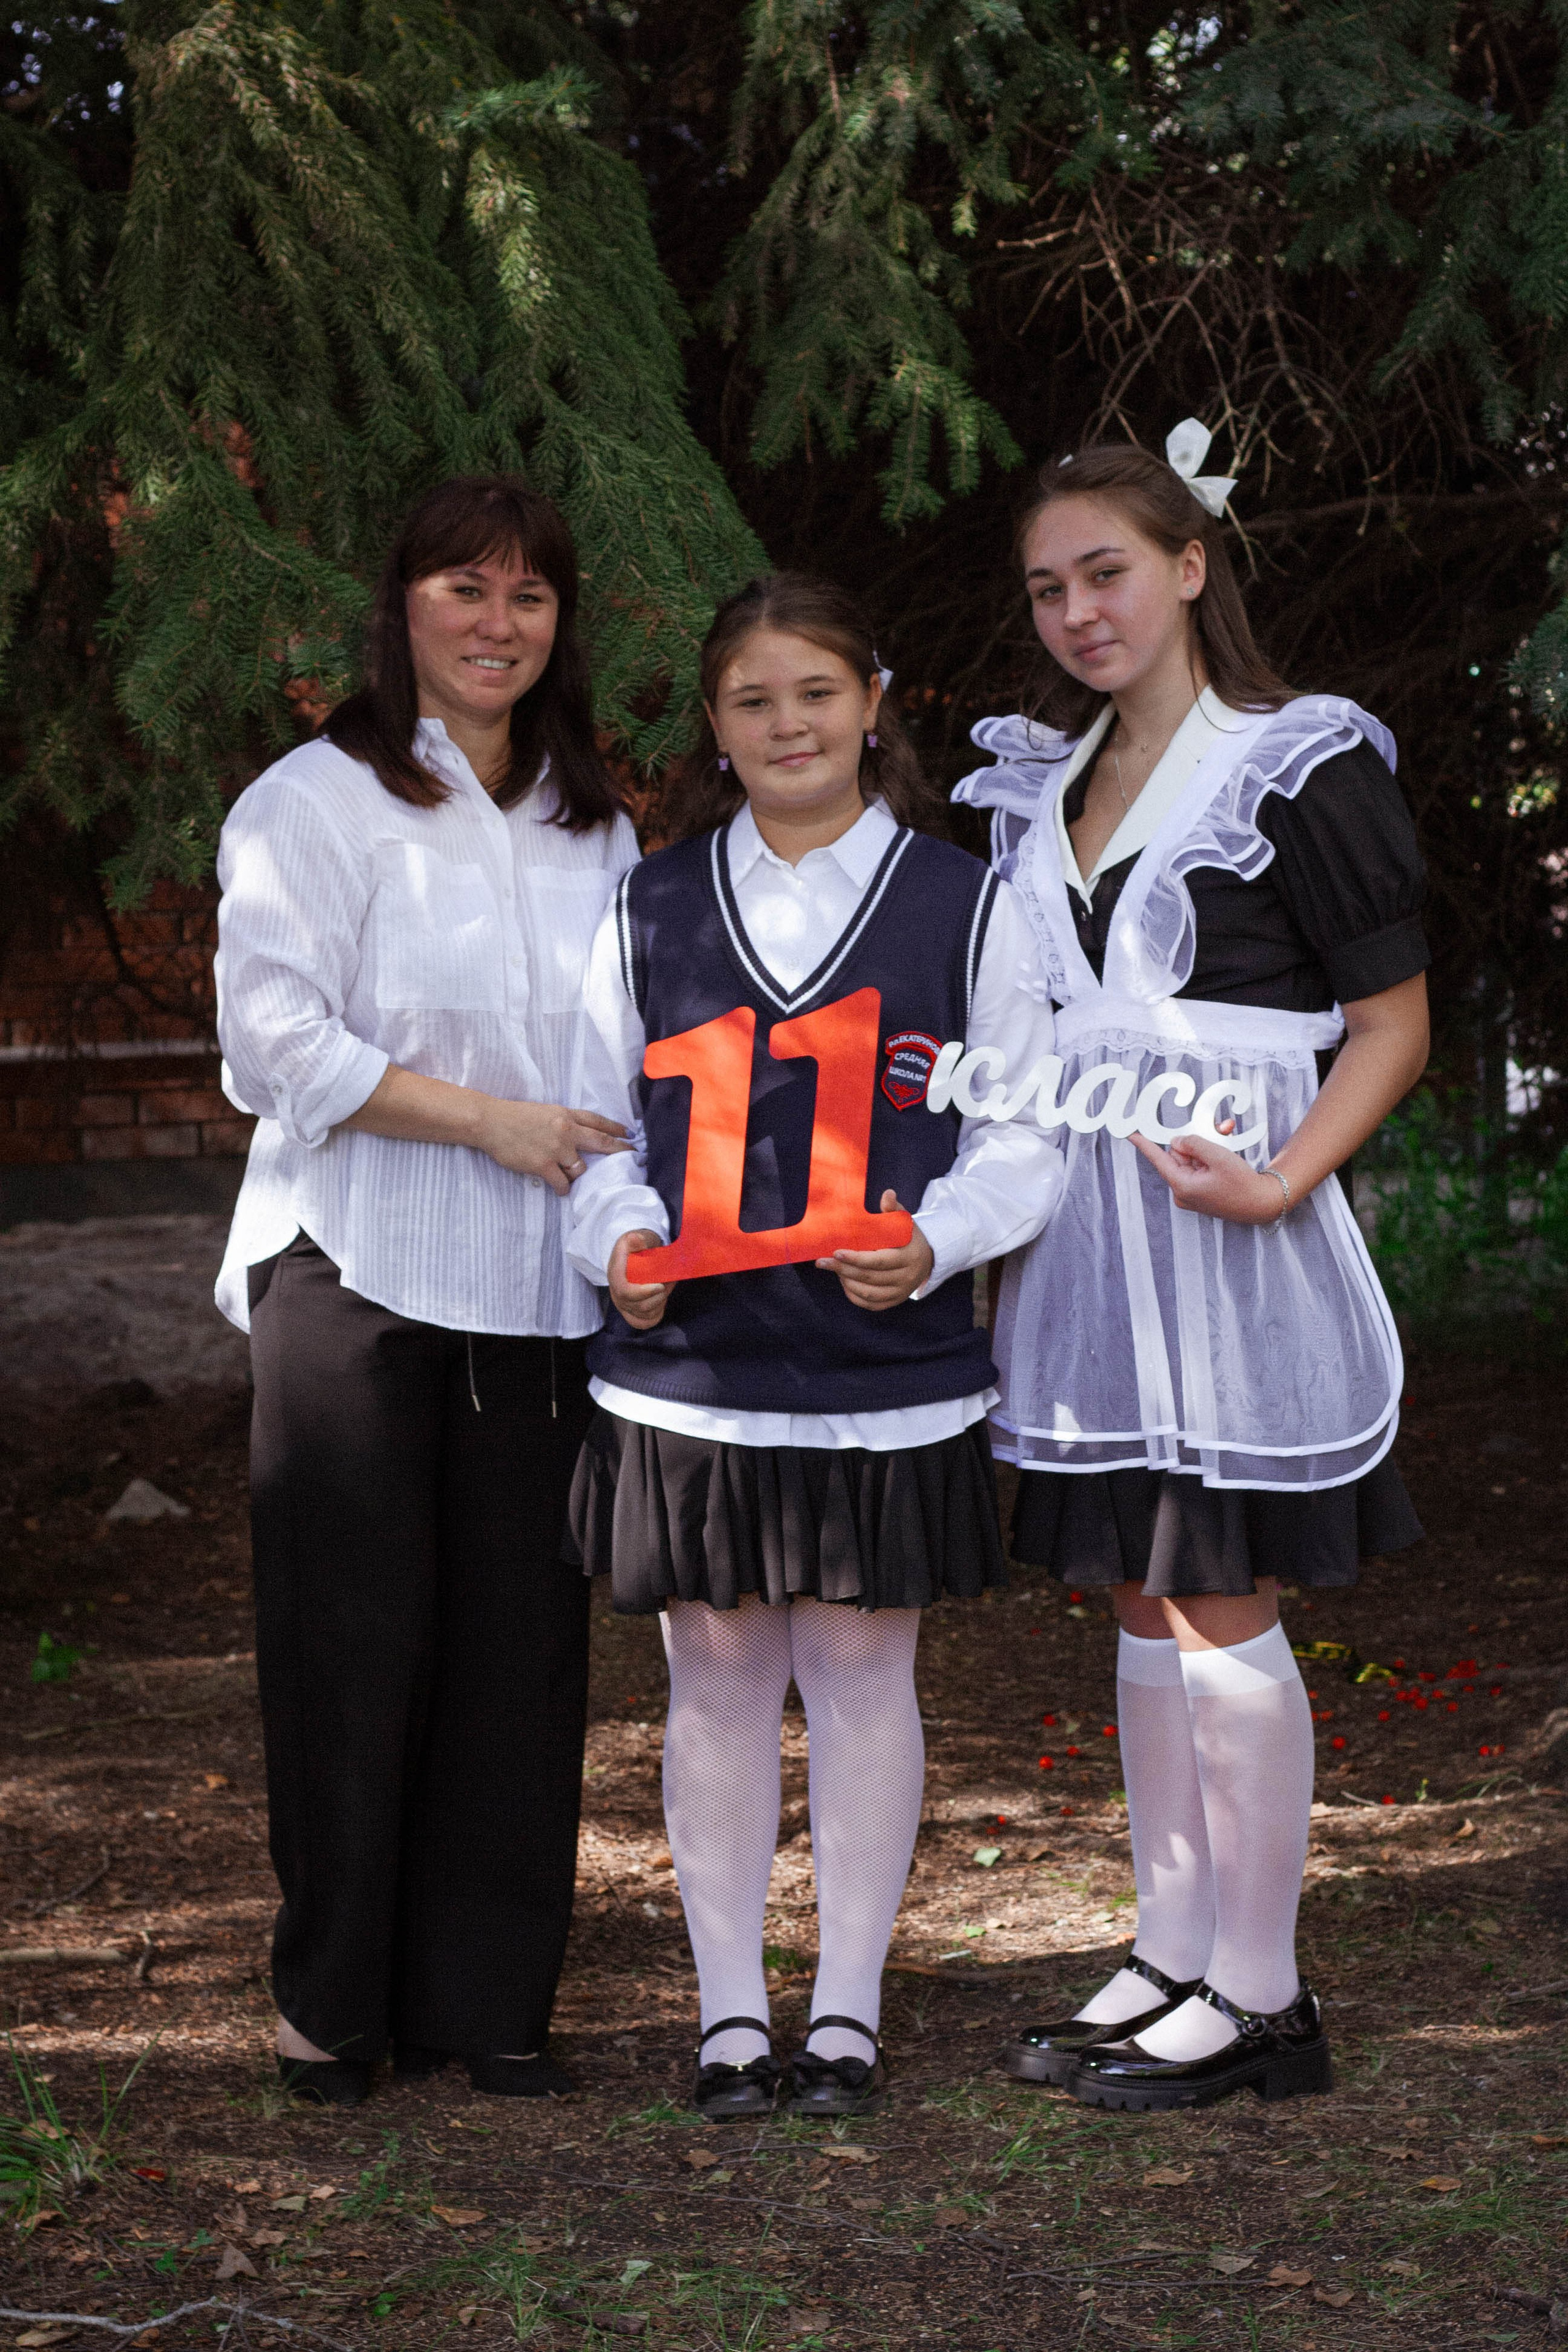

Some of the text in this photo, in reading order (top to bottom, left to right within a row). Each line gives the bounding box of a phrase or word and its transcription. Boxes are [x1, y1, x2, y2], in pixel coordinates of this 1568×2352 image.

[894, 1052, 930, 1069] СРЕДНЯЯ
[927, 1041, 1268, 1152] класс
[625, 987, 913, 1284] 11
